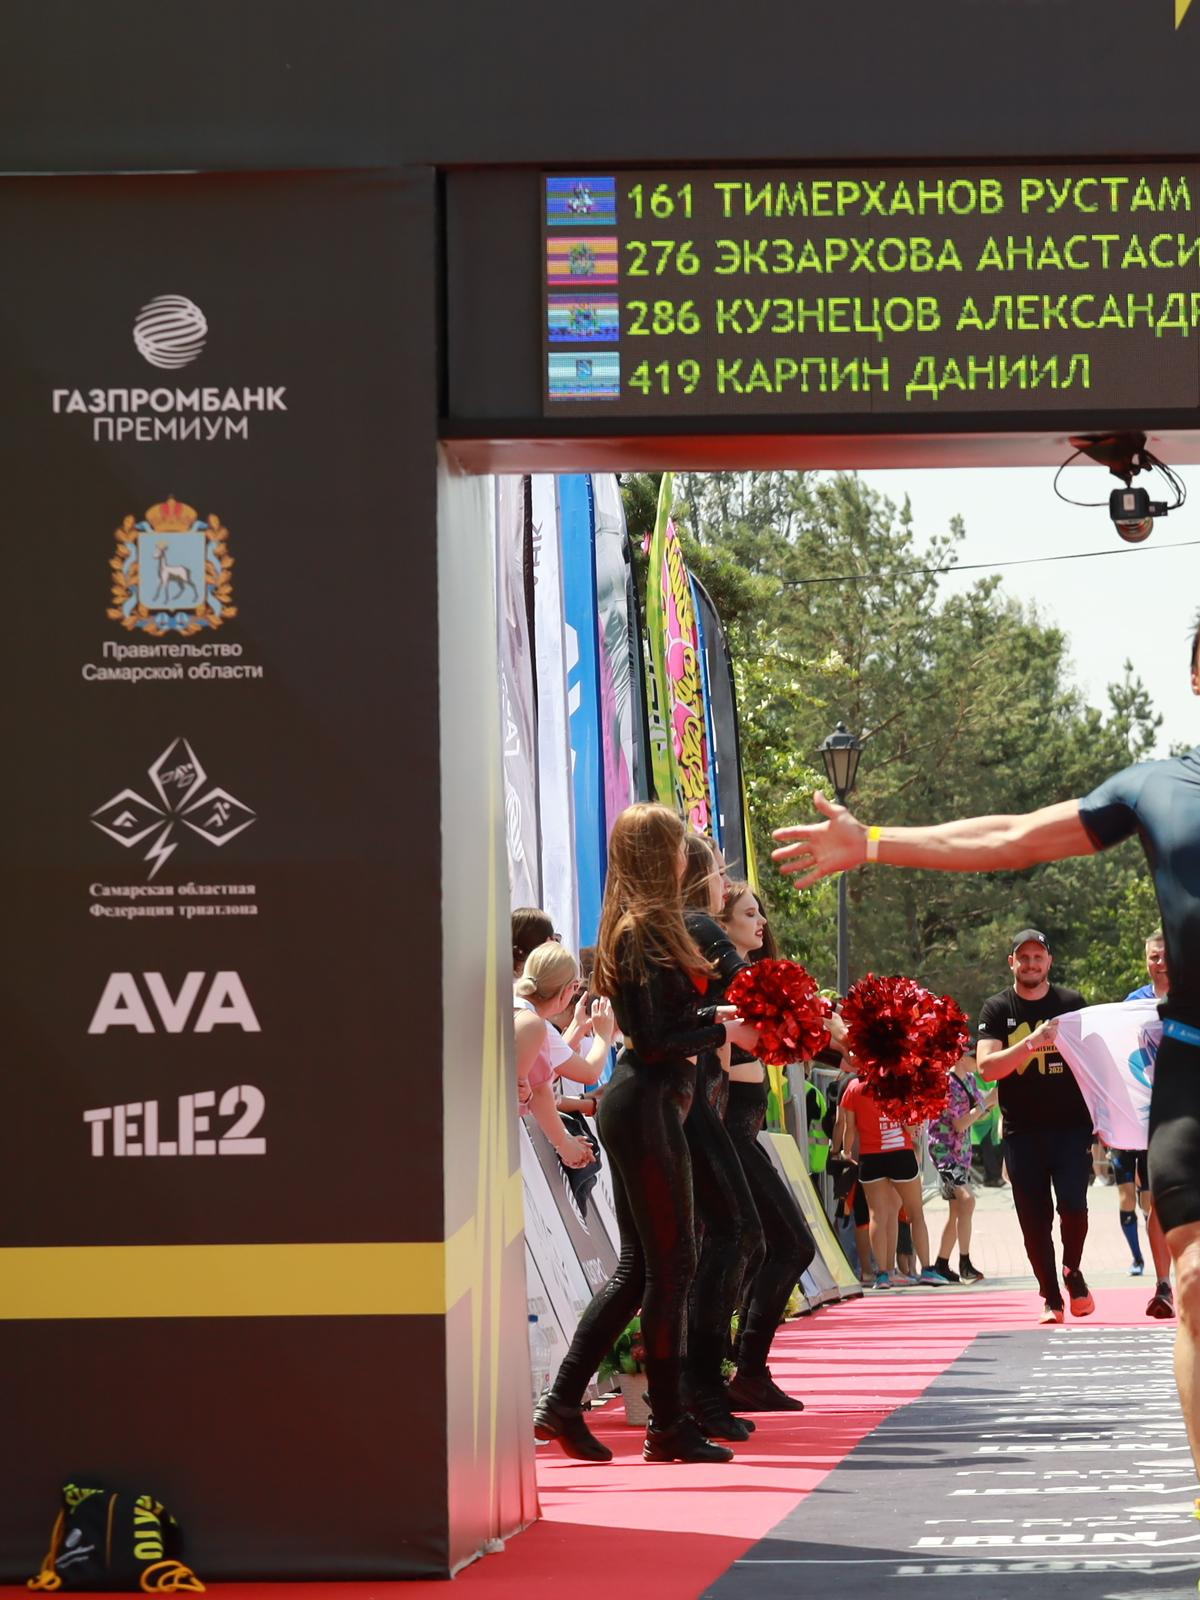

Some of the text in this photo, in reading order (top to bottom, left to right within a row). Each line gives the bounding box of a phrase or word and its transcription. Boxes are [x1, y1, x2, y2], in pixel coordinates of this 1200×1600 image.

[628, 183, 693, 218] 161
[714, 178, 1005, 217] ТИМЕРХАНОВ
[1021, 176, 1192, 213] РУСТАМ
[626, 239, 701, 276] 276
[715, 236, 963, 274] ЭКЗАРХОВА
[627, 300, 702, 336] 286
[717, 296, 942, 340] КУЗНЕЦОВ
[629, 359, 701, 395] 419
[717, 357, 891, 394] КАРПИН
[905, 353, 1091, 400] ДАНИИЛ
[52, 386, 287, 414] ГАЗПРОМБАНК
[93, 416, 248, 442] ПРЕМИУМ
[103, 641, 243, 661] Правительство
[82, 662, 263, 683] Самарской области
[89, 882, 256, 900] Самарская областная
[89, 903, 258, 920] Федерация триатлона
[87, 970, 262, 1034] AVA
[83, 1084, 267, 1157] TELE2
[916, 1531, 1158, 1546] IRON
[896, 1560, 1153, 1576] IRON
